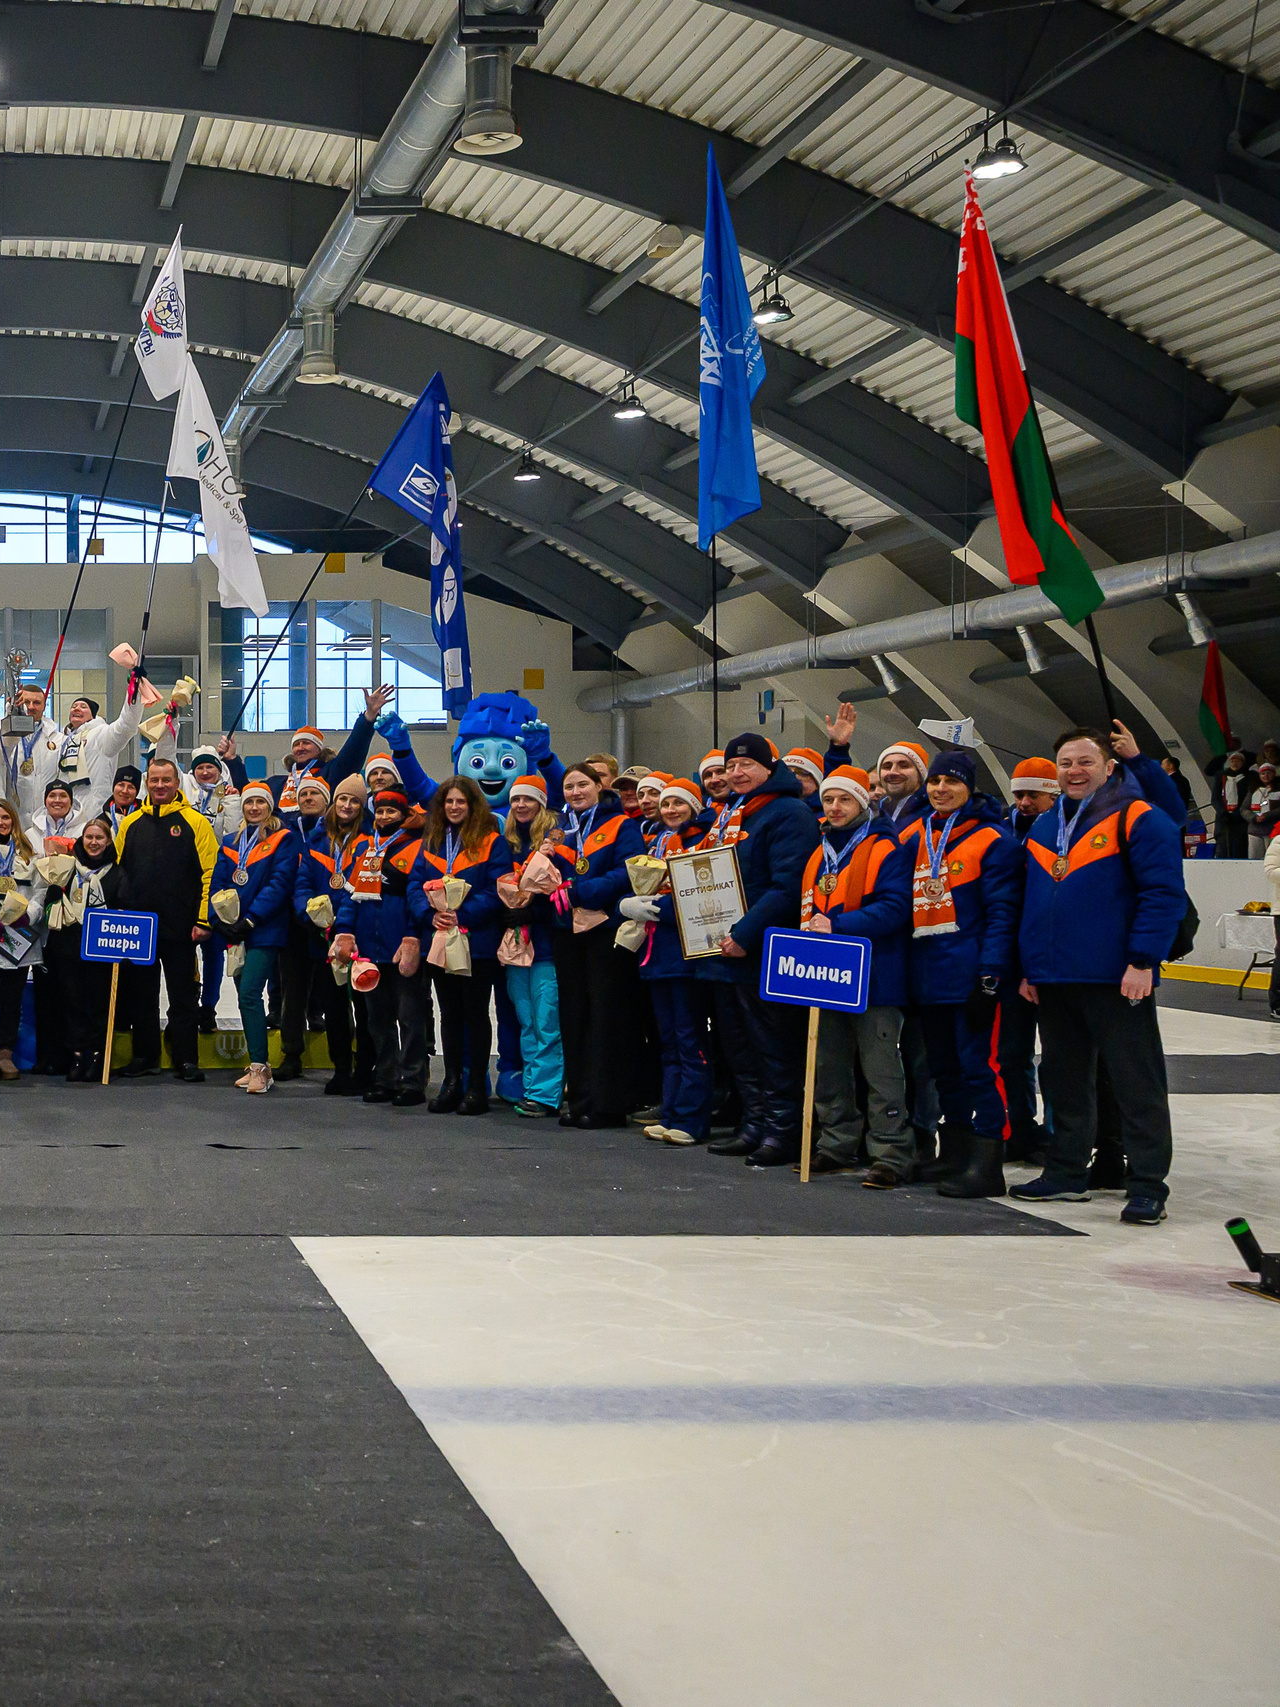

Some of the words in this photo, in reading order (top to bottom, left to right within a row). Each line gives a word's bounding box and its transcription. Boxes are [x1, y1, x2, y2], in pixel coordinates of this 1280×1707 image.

[680, 881, 735, 897] СЕРТИФИКАТ
[101, 919, 140, 935] Белые
[97, 937, 140, 953] тигры
[778, 956, 852, 985] Молния
